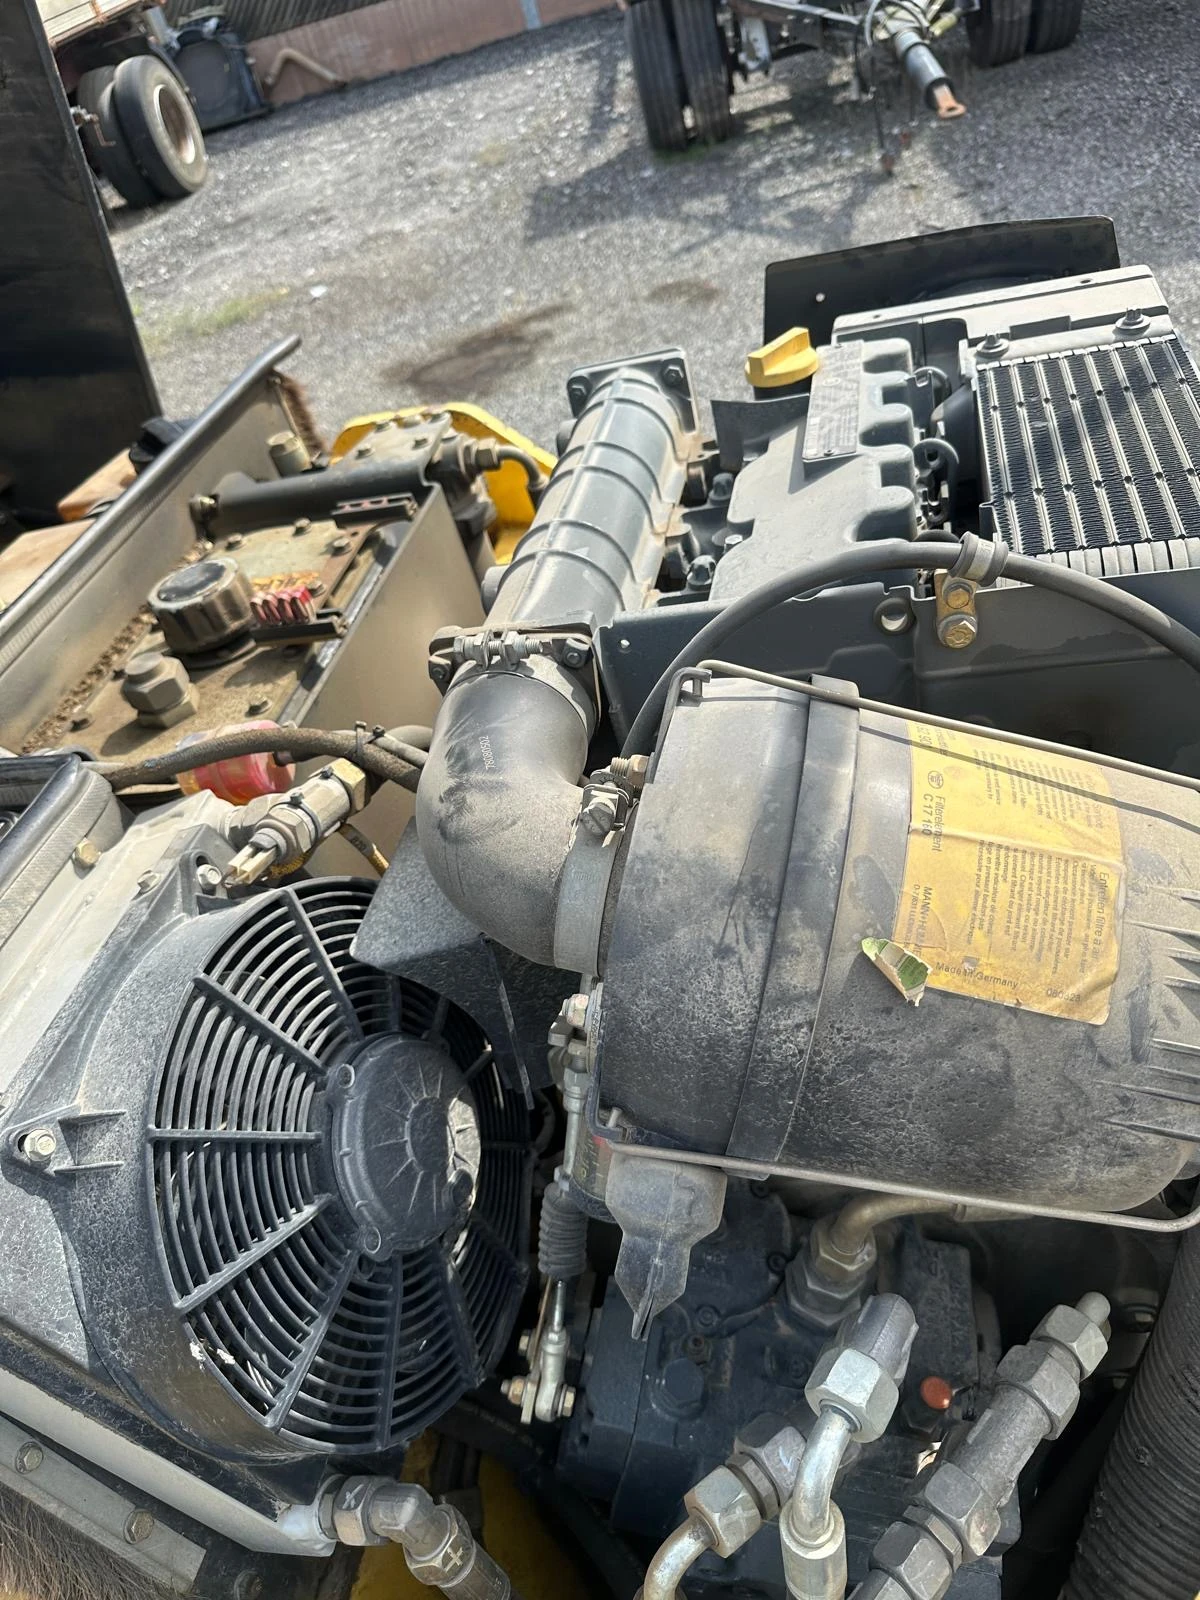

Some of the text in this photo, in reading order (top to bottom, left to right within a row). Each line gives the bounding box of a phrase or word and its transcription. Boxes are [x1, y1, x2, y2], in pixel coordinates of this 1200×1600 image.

[922, 803, 933, 816] 17
[931, 795, 946, 852] Filterelement
[1097, 871, 1109, 914] Entretien
[1094, 915, 1105, 937] filtre
[934, 961, 962, 976] Made
[973, 970, 1018, 990] Germany
